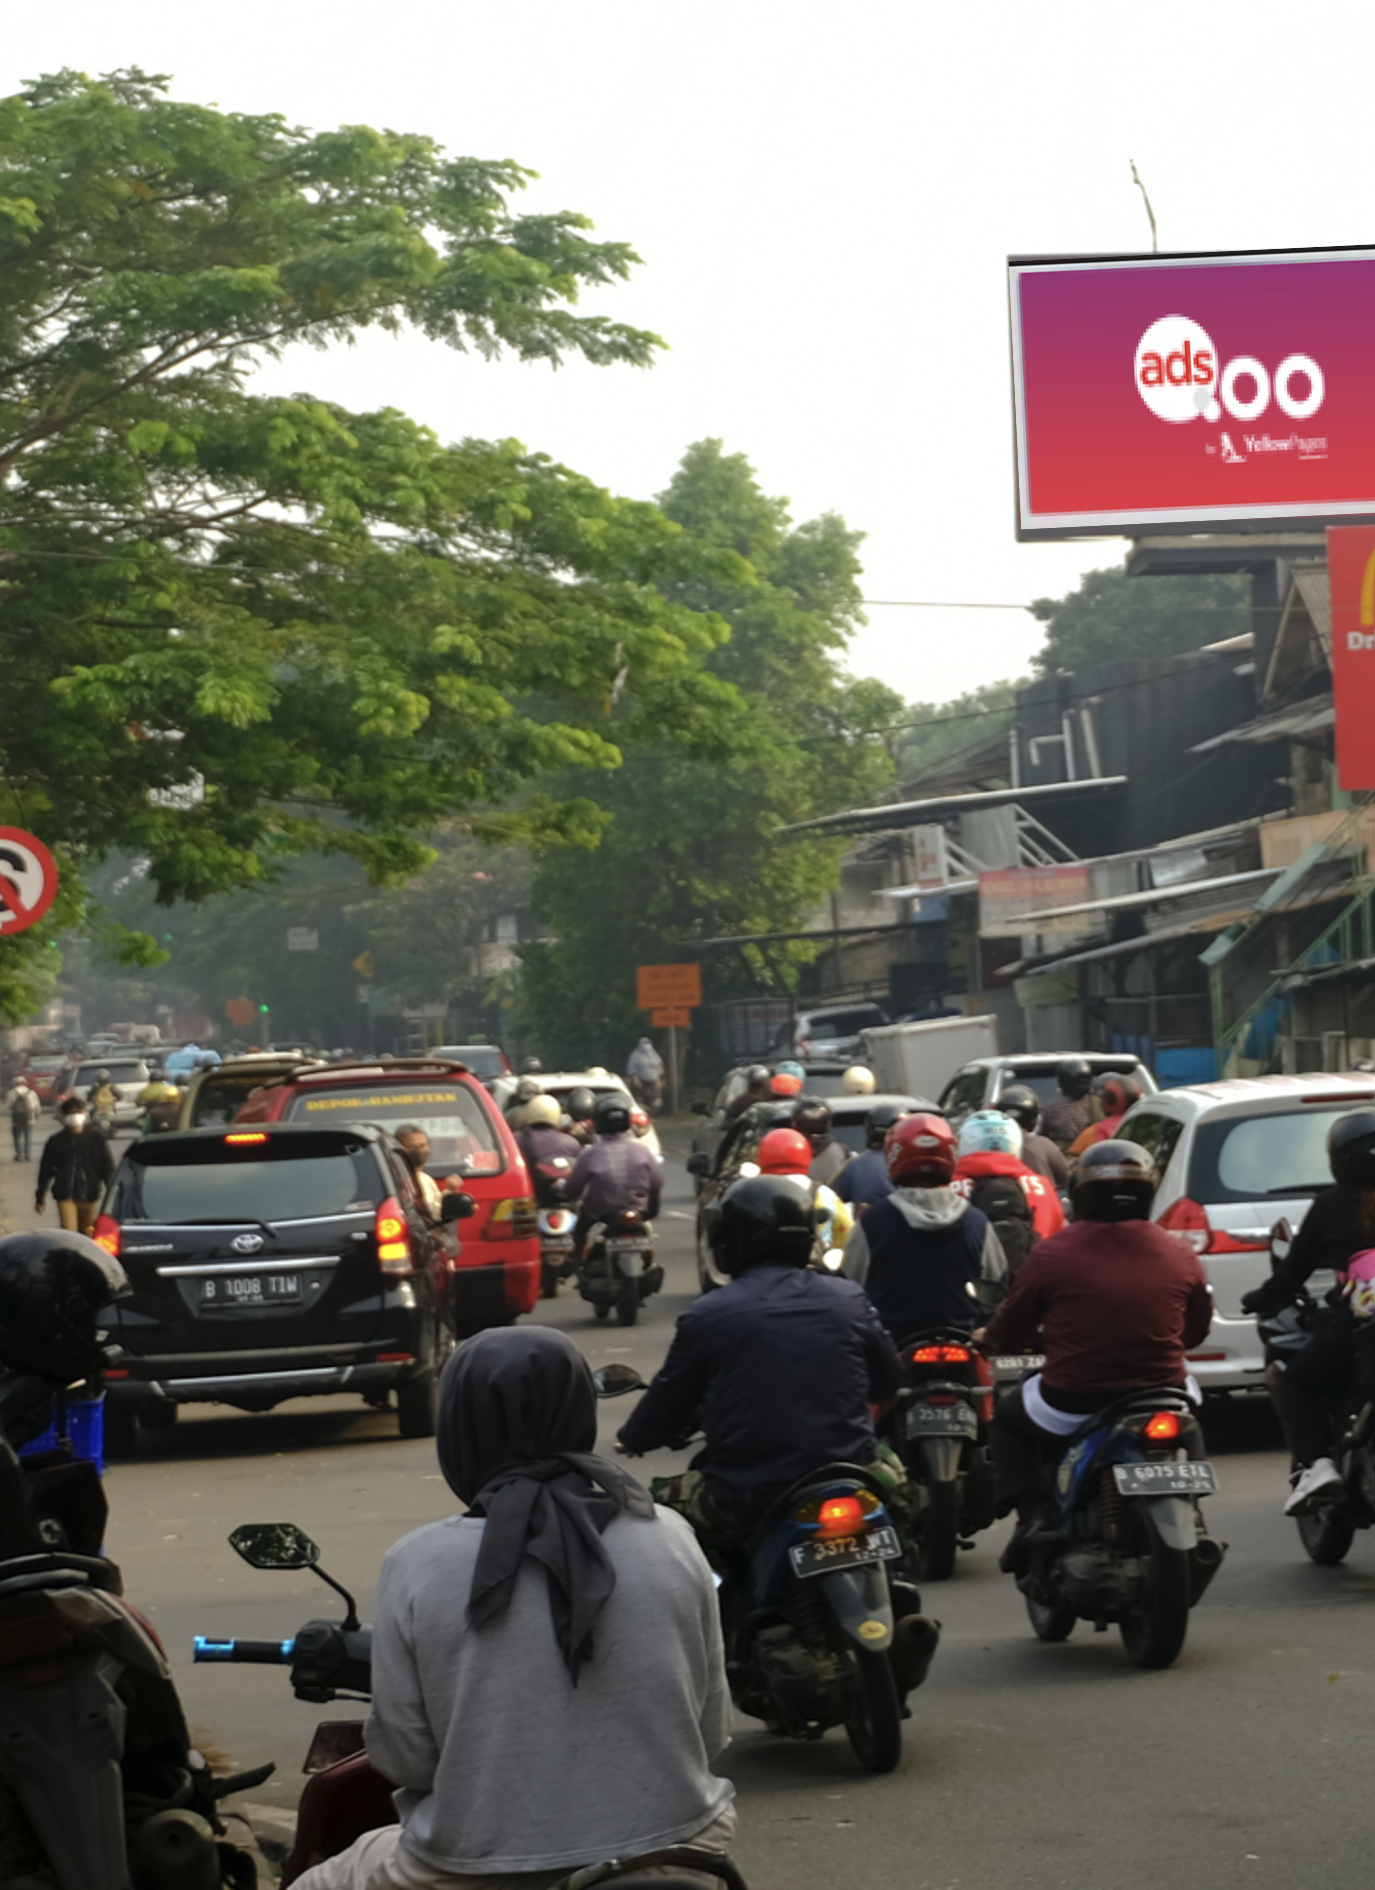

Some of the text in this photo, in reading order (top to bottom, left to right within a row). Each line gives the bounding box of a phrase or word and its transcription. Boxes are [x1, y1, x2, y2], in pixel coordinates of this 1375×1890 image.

[1140, 338, 1214, 386] ads
[306, 1099, 362, 1112] DEPOK
[205, 1280, 216, 1298] B
[226, 1278, 262, 1296] 1008
[793, 1546, 806, 1564] F
